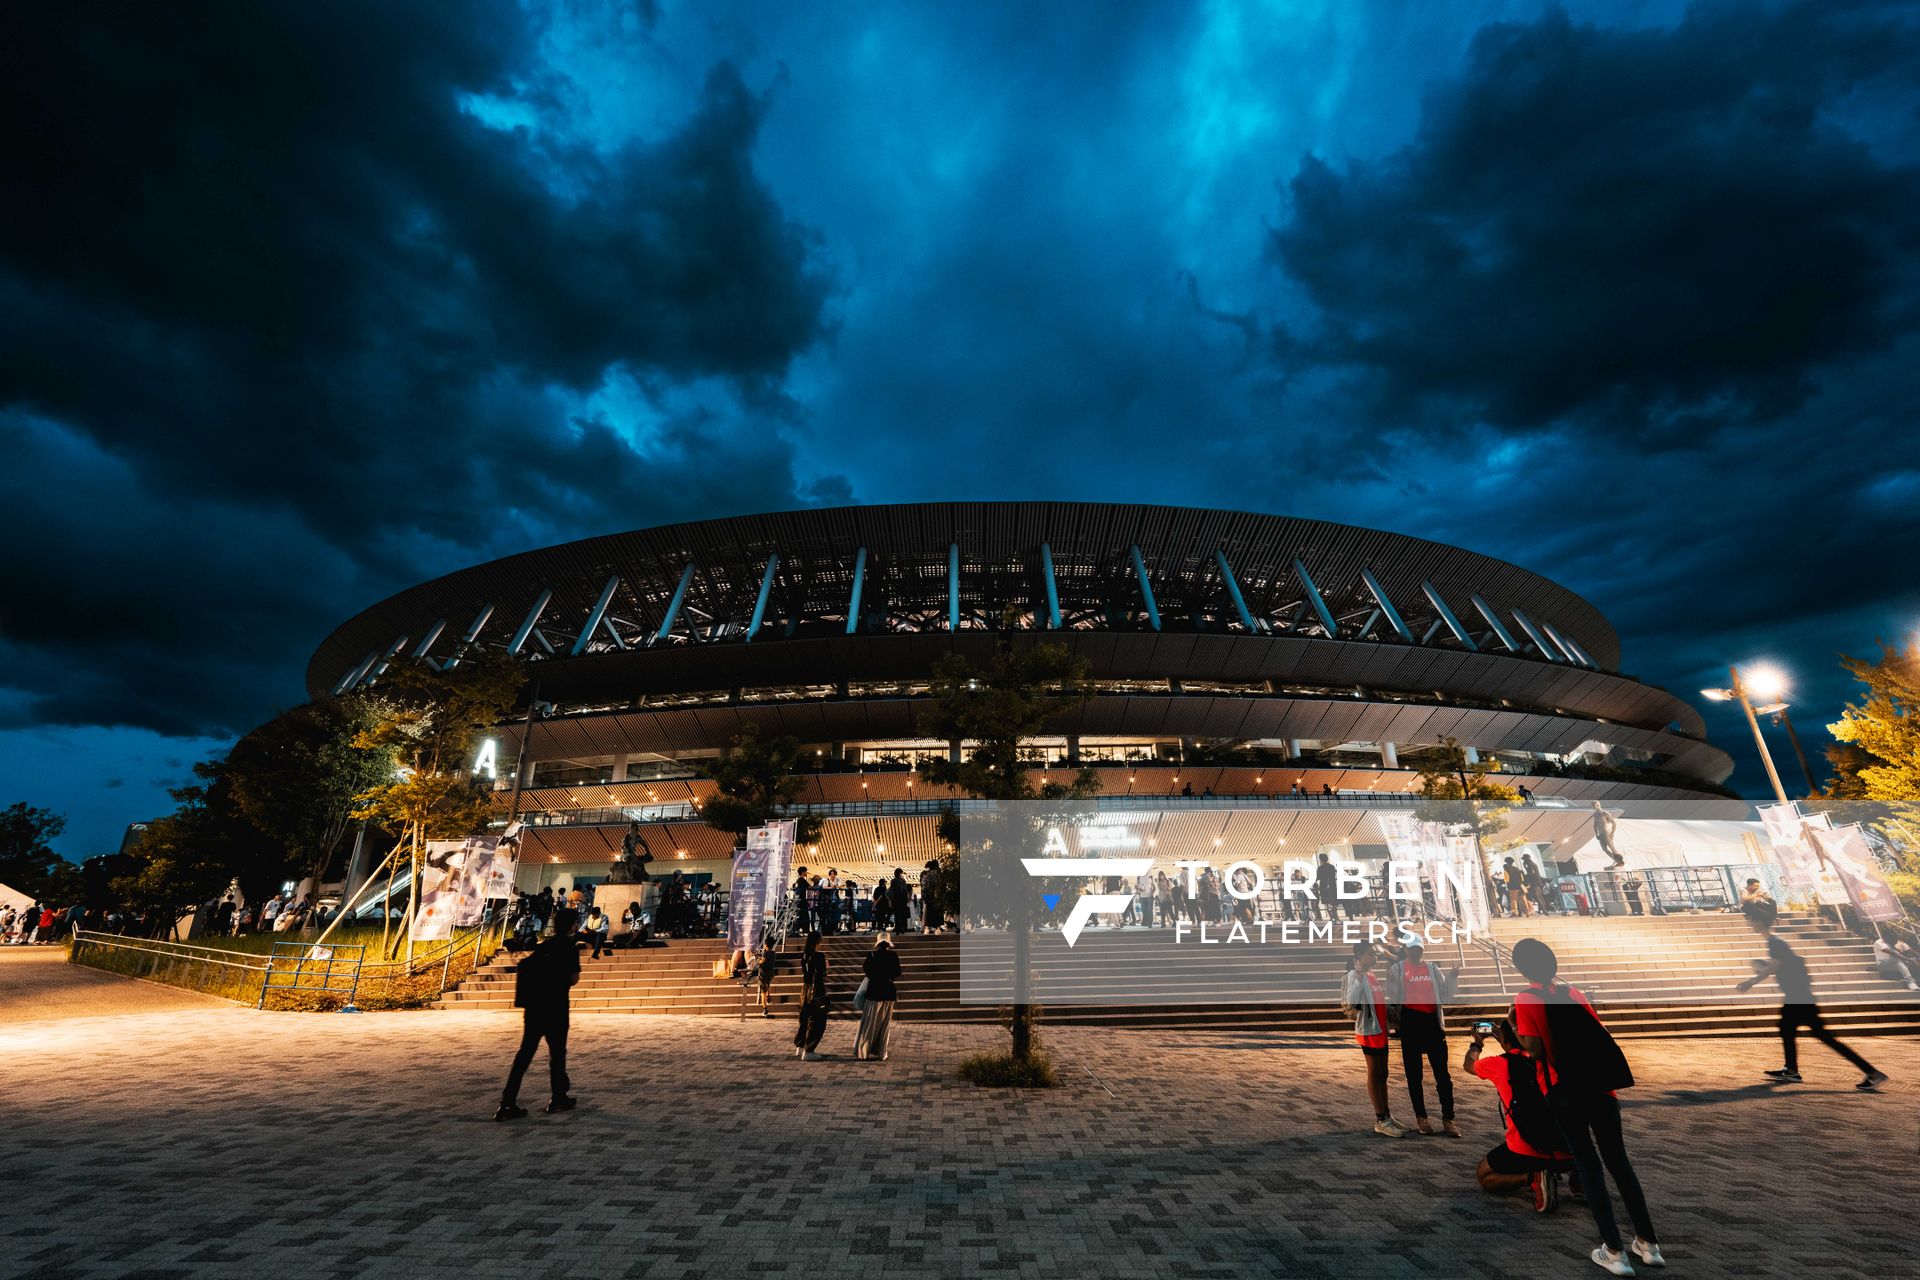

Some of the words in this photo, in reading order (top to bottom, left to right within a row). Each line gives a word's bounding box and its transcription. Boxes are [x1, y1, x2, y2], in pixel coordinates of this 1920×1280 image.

[473, 738, 497, 779] A
[1043, 827, 1069, 856] A
[282, 881, 295, 892] A1
